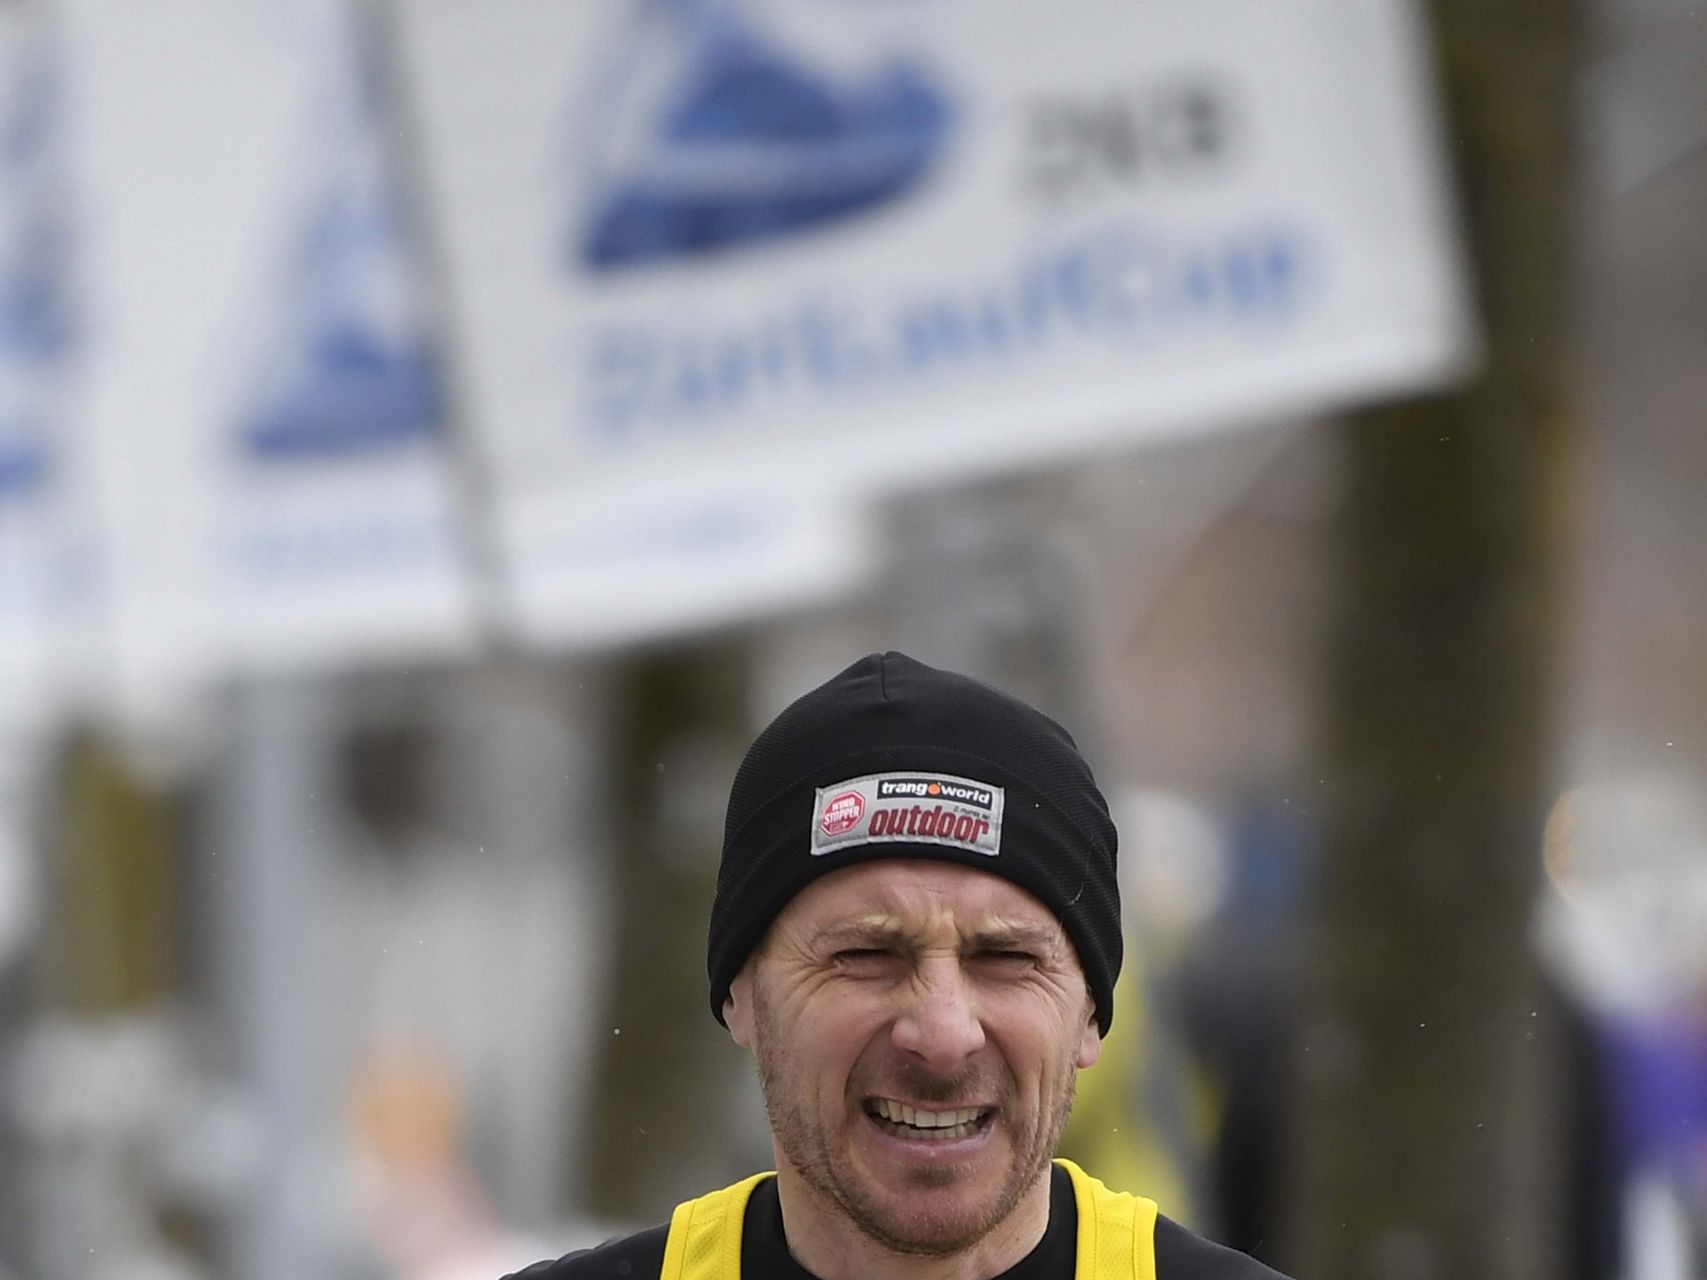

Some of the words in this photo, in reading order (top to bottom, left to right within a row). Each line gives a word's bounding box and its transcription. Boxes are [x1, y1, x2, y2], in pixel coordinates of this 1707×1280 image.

[831, 797, 856, 812] WIND
[823, 805, 860, 825] STOPPER
[869, 805, 989, 844] outdoor
